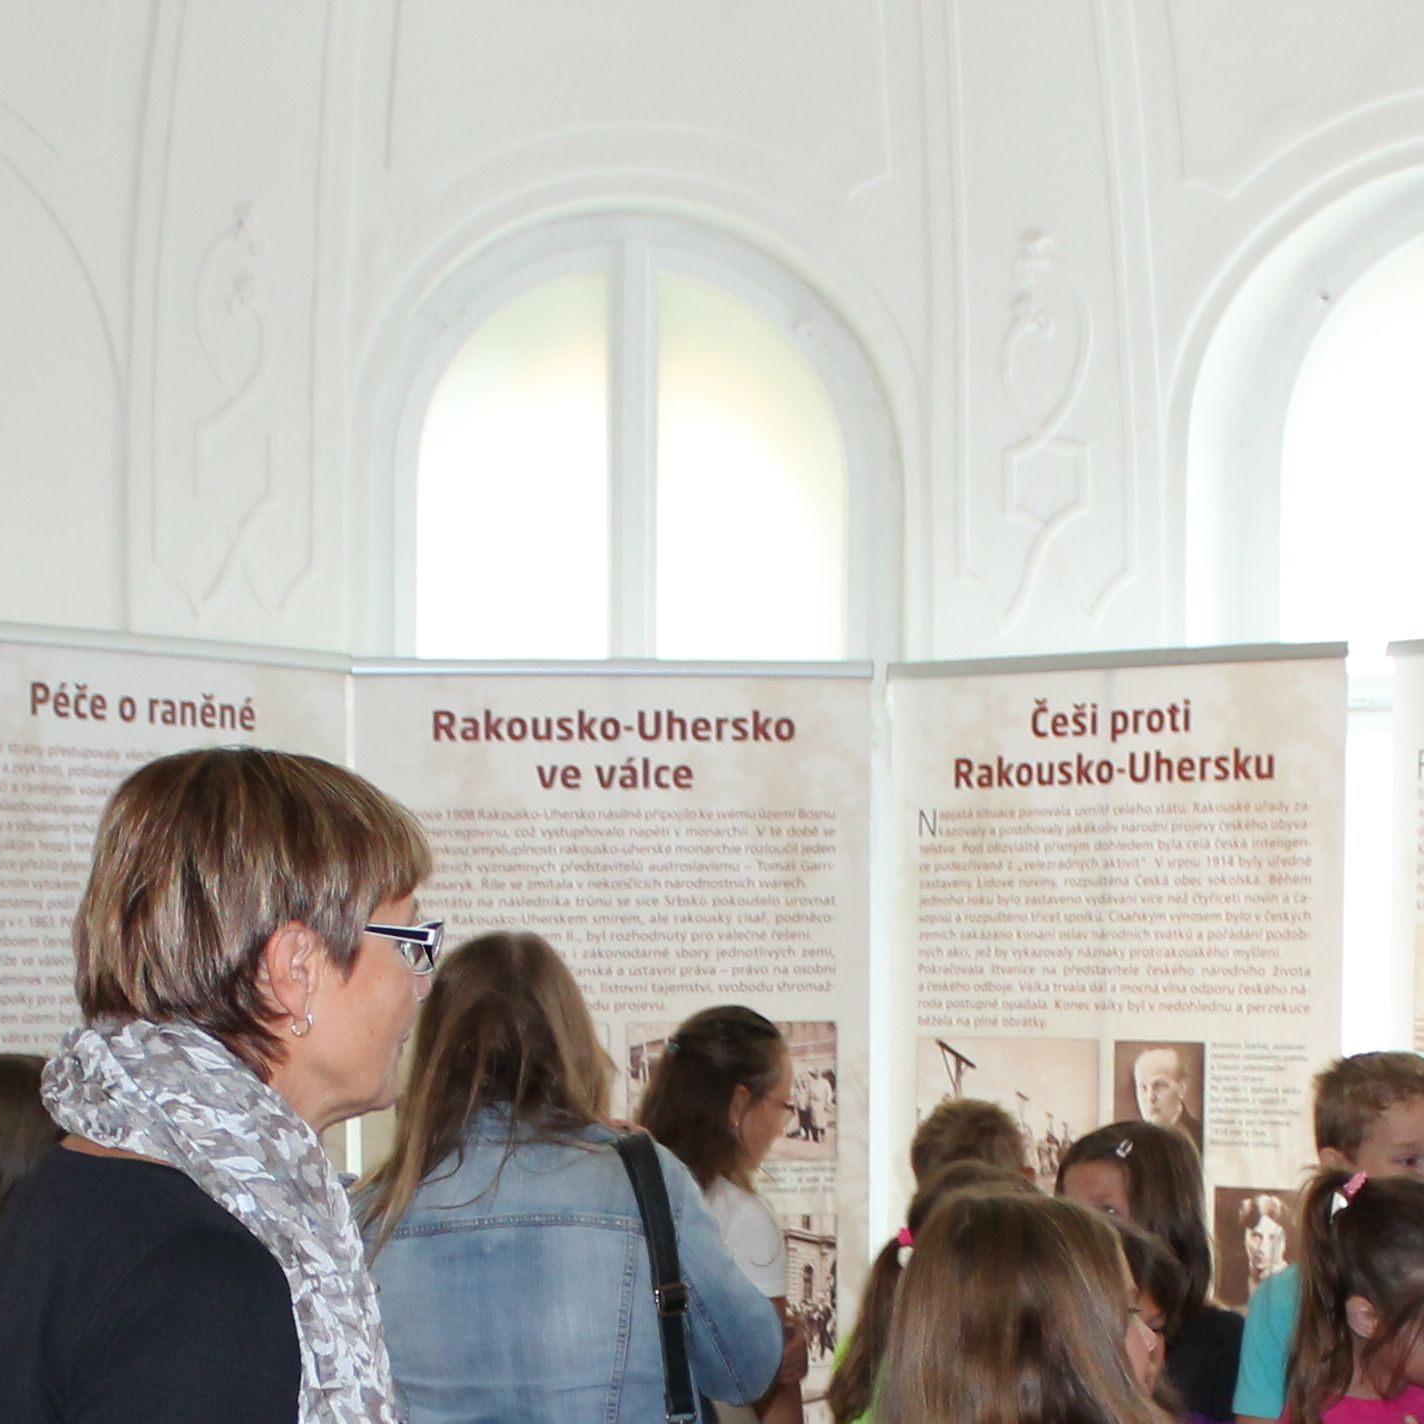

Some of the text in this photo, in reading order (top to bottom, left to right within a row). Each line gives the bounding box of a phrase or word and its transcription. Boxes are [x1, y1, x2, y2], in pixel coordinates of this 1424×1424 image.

[30, 681, 256, 732] Péče o raněné
[432, 708, 796, 742] Rakousko-Uhersko
[1031, 698, 1191, 744] Češi proti
[536, 756, 694, 790] ve válce
[954, 746, 1274, 790] Rakousko-Uhersku
